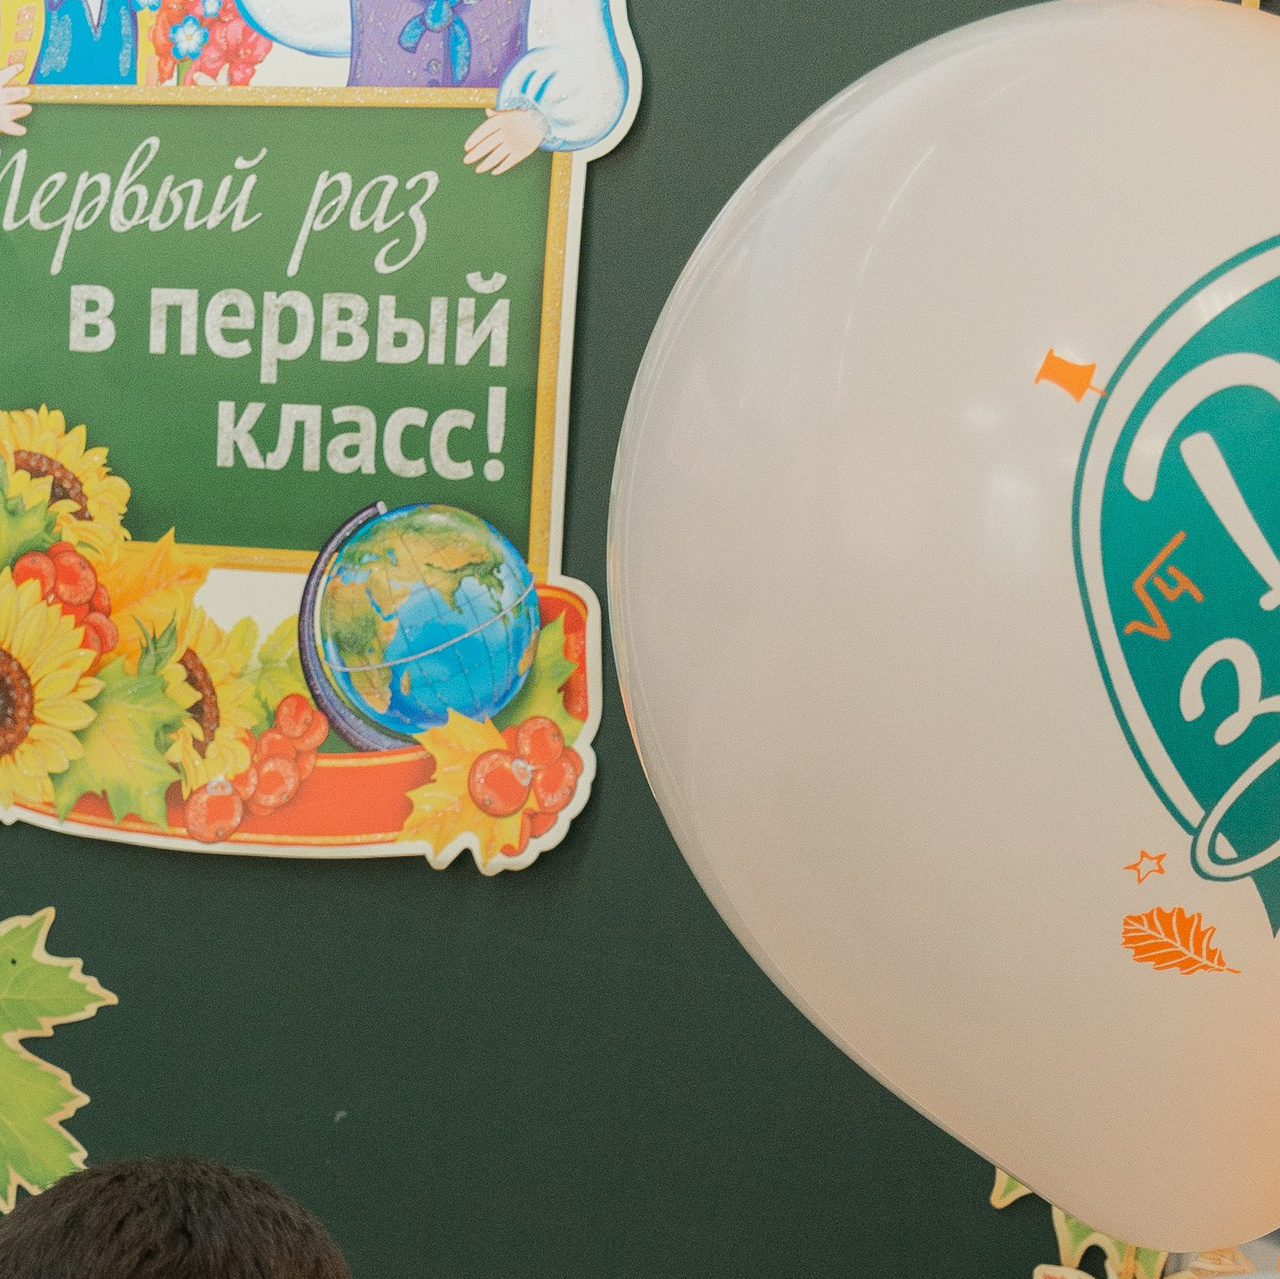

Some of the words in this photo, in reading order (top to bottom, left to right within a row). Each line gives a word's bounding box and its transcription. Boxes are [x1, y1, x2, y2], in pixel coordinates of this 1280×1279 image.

[287, 163, 440, 276] раз
[68, 284, 115, 353] в
[149, 271, 510, 385] первый
[216, 386, 507, 482] класс!
